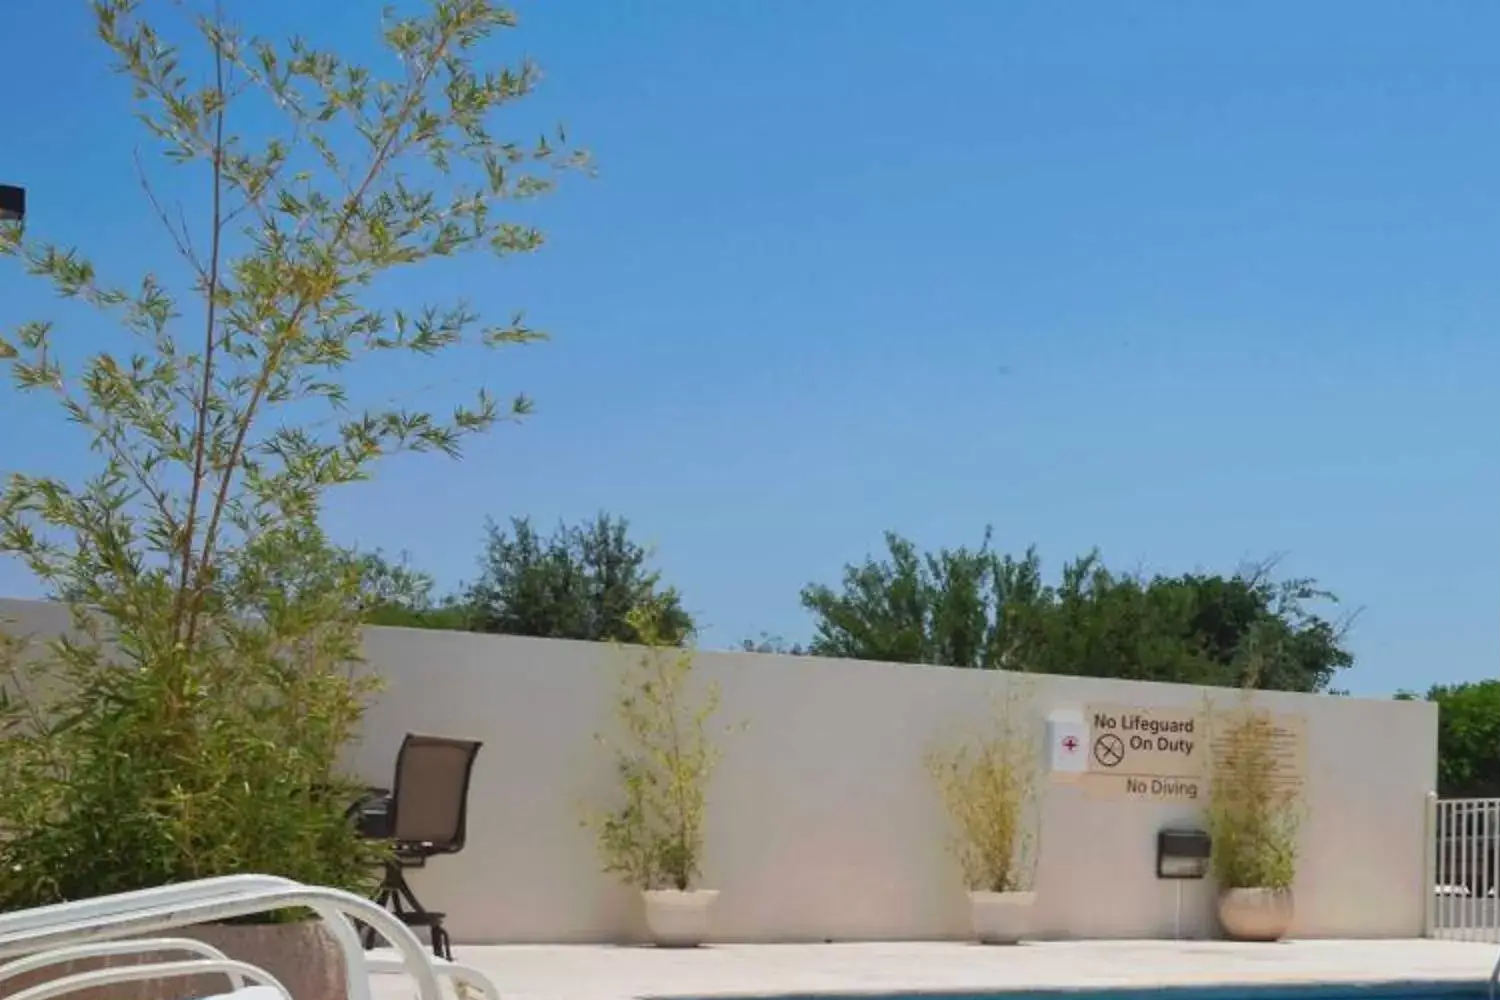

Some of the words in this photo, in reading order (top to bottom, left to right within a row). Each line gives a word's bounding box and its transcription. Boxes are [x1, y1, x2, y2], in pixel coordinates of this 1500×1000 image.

[1094, 714, 1117, 729] No
[1121, 715, 1194, 734] Lifeguard
[1130, 735, 1153, 750] On
[1157, 737, 1193, 756] Duty
[1127, 778, 1147, 793] No
[1151, 780, 1197, 799] Diving
